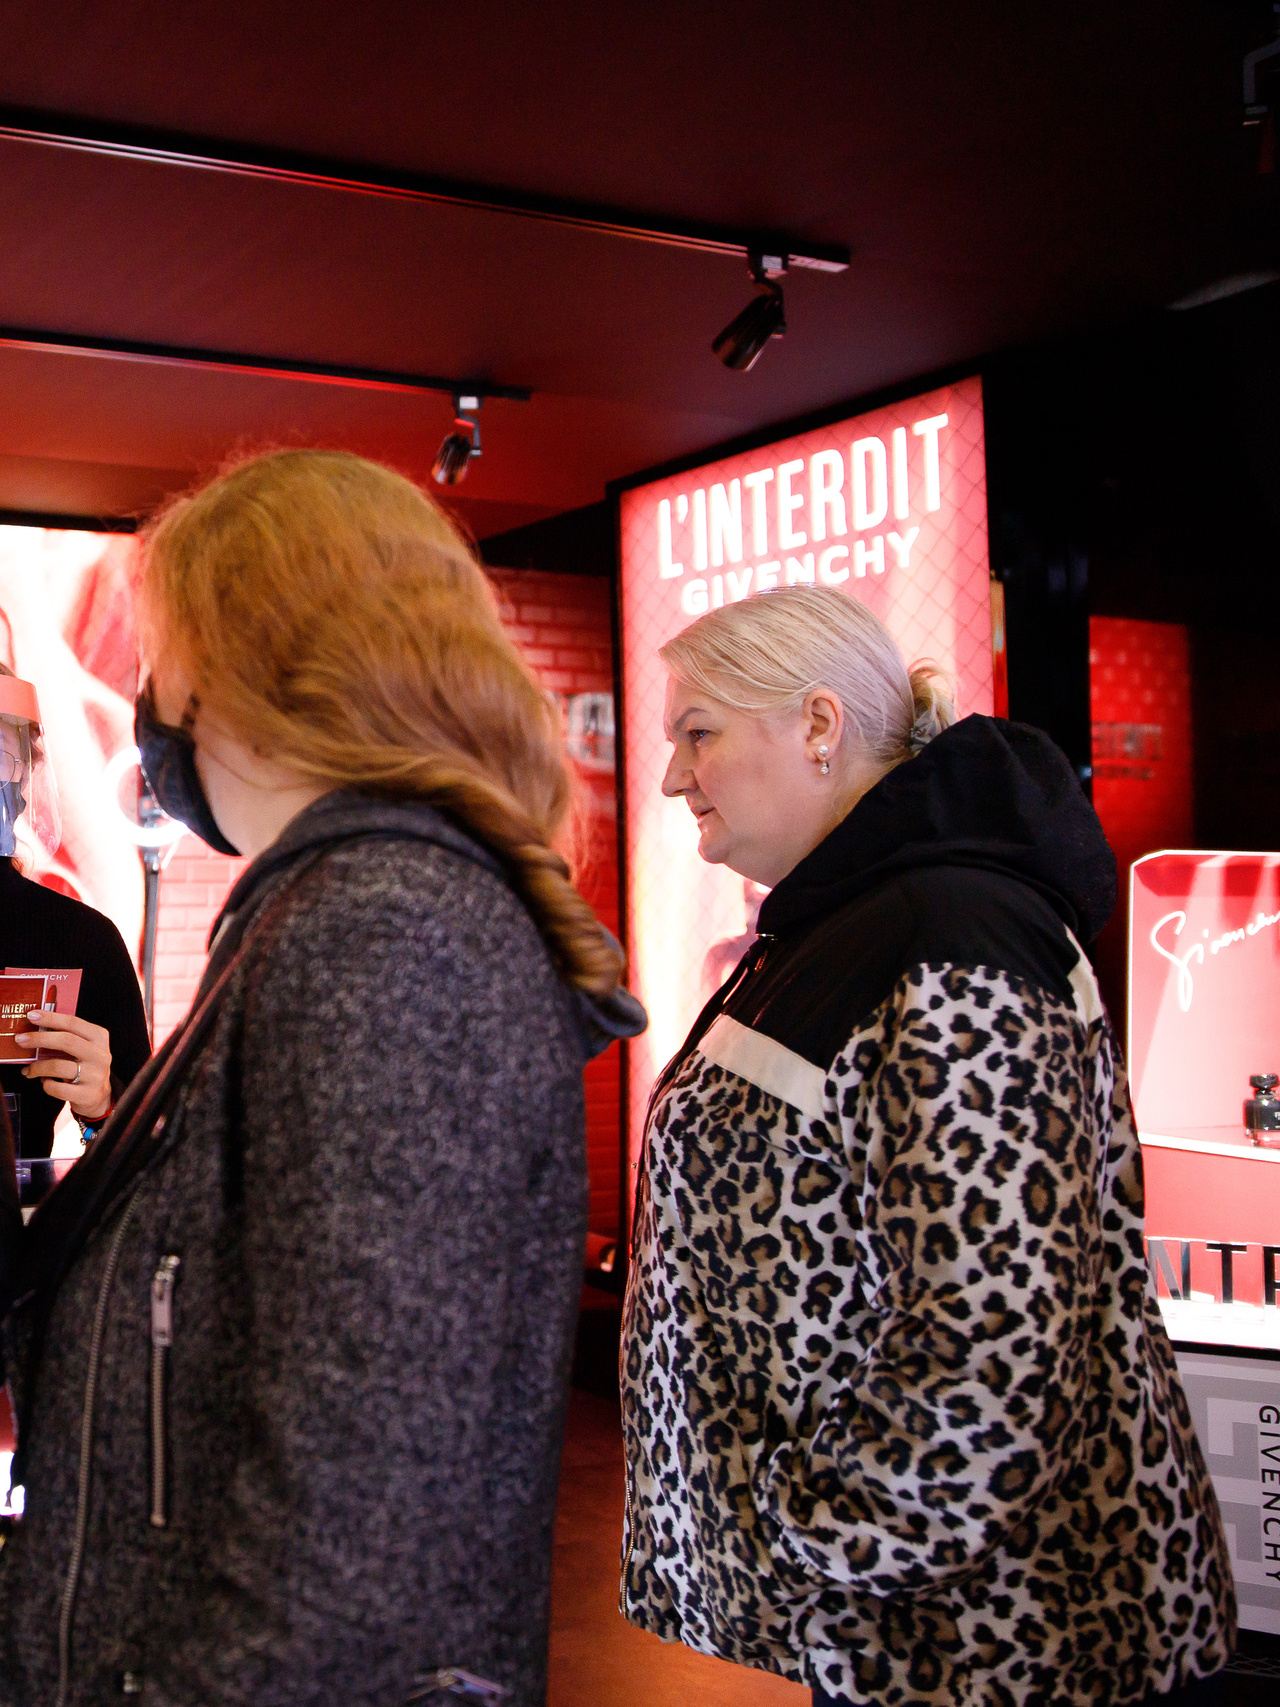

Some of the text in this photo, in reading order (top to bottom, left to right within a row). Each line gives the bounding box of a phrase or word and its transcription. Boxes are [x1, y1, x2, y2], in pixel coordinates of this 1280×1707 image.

[658, 413, 949, 579] L'INTERDIT
[681, 526, 920, 615] GIVENCHY
[1258, 1405, 1280, 1584] GIVENCHY
